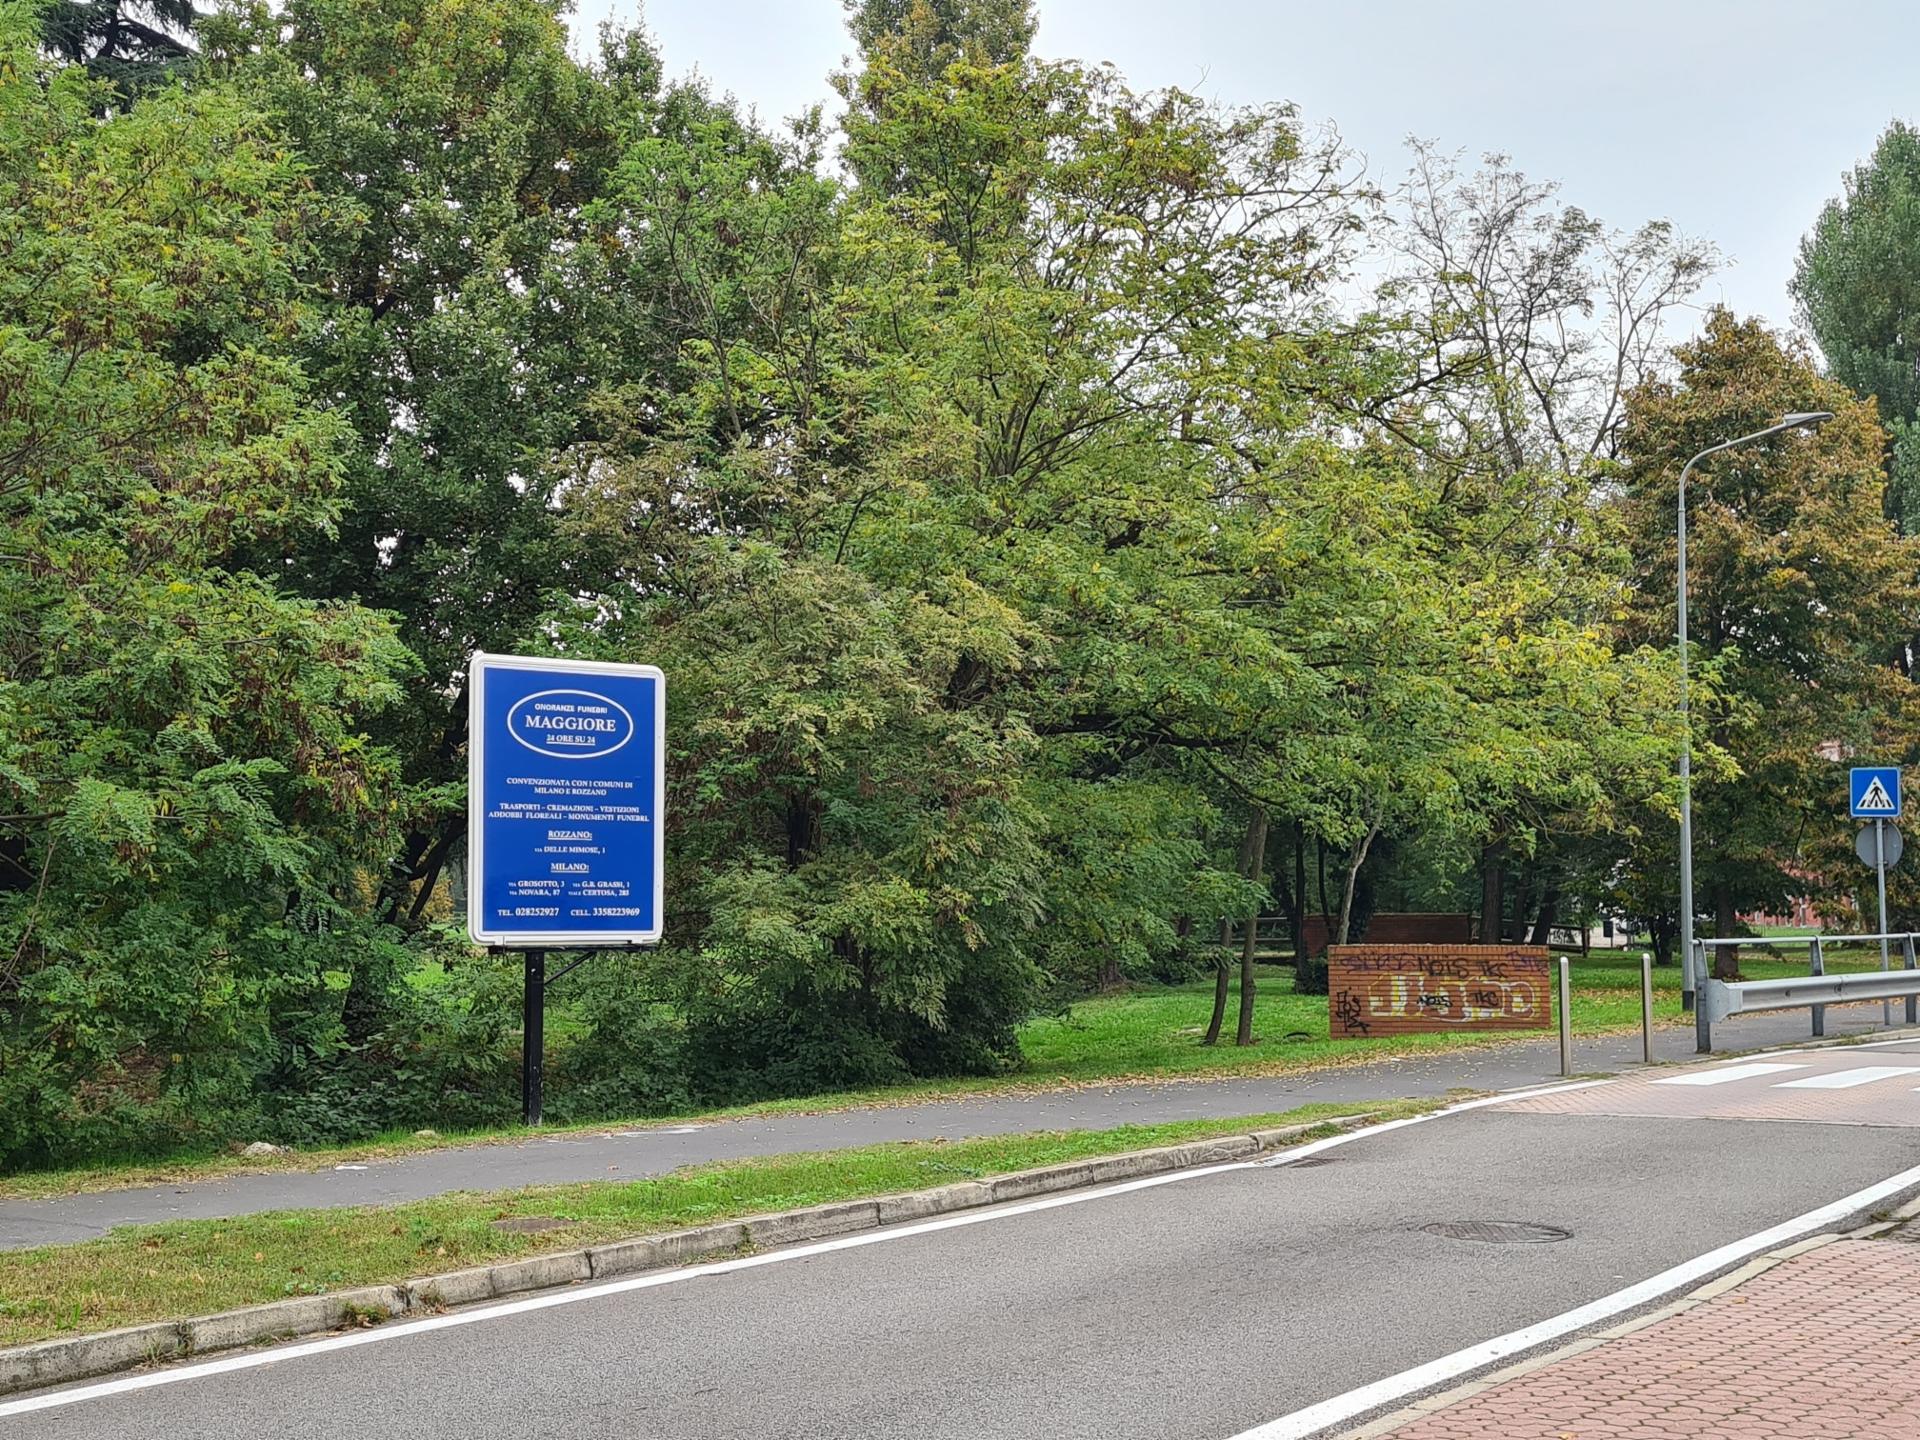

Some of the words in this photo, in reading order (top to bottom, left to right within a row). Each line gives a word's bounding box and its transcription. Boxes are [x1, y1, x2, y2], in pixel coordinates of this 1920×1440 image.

[534, 703, 575, 712] ONORANZE
[578, 705, 608, 714] FUNEBRI
[525, 715, 616, 732] MAGGIORE
[556, 734, 573, 742] ORE
[575, 735, 587, 743] SU
[506, 777, 570, 787] CONVENZIONATA
[547, 804, 594, 812] CREMAZIONI
[548, 830, 592, 839] ROZZANO:
[550, 862, 589, 871] MILANO:
[515, 908, 559, 916] 028252927
